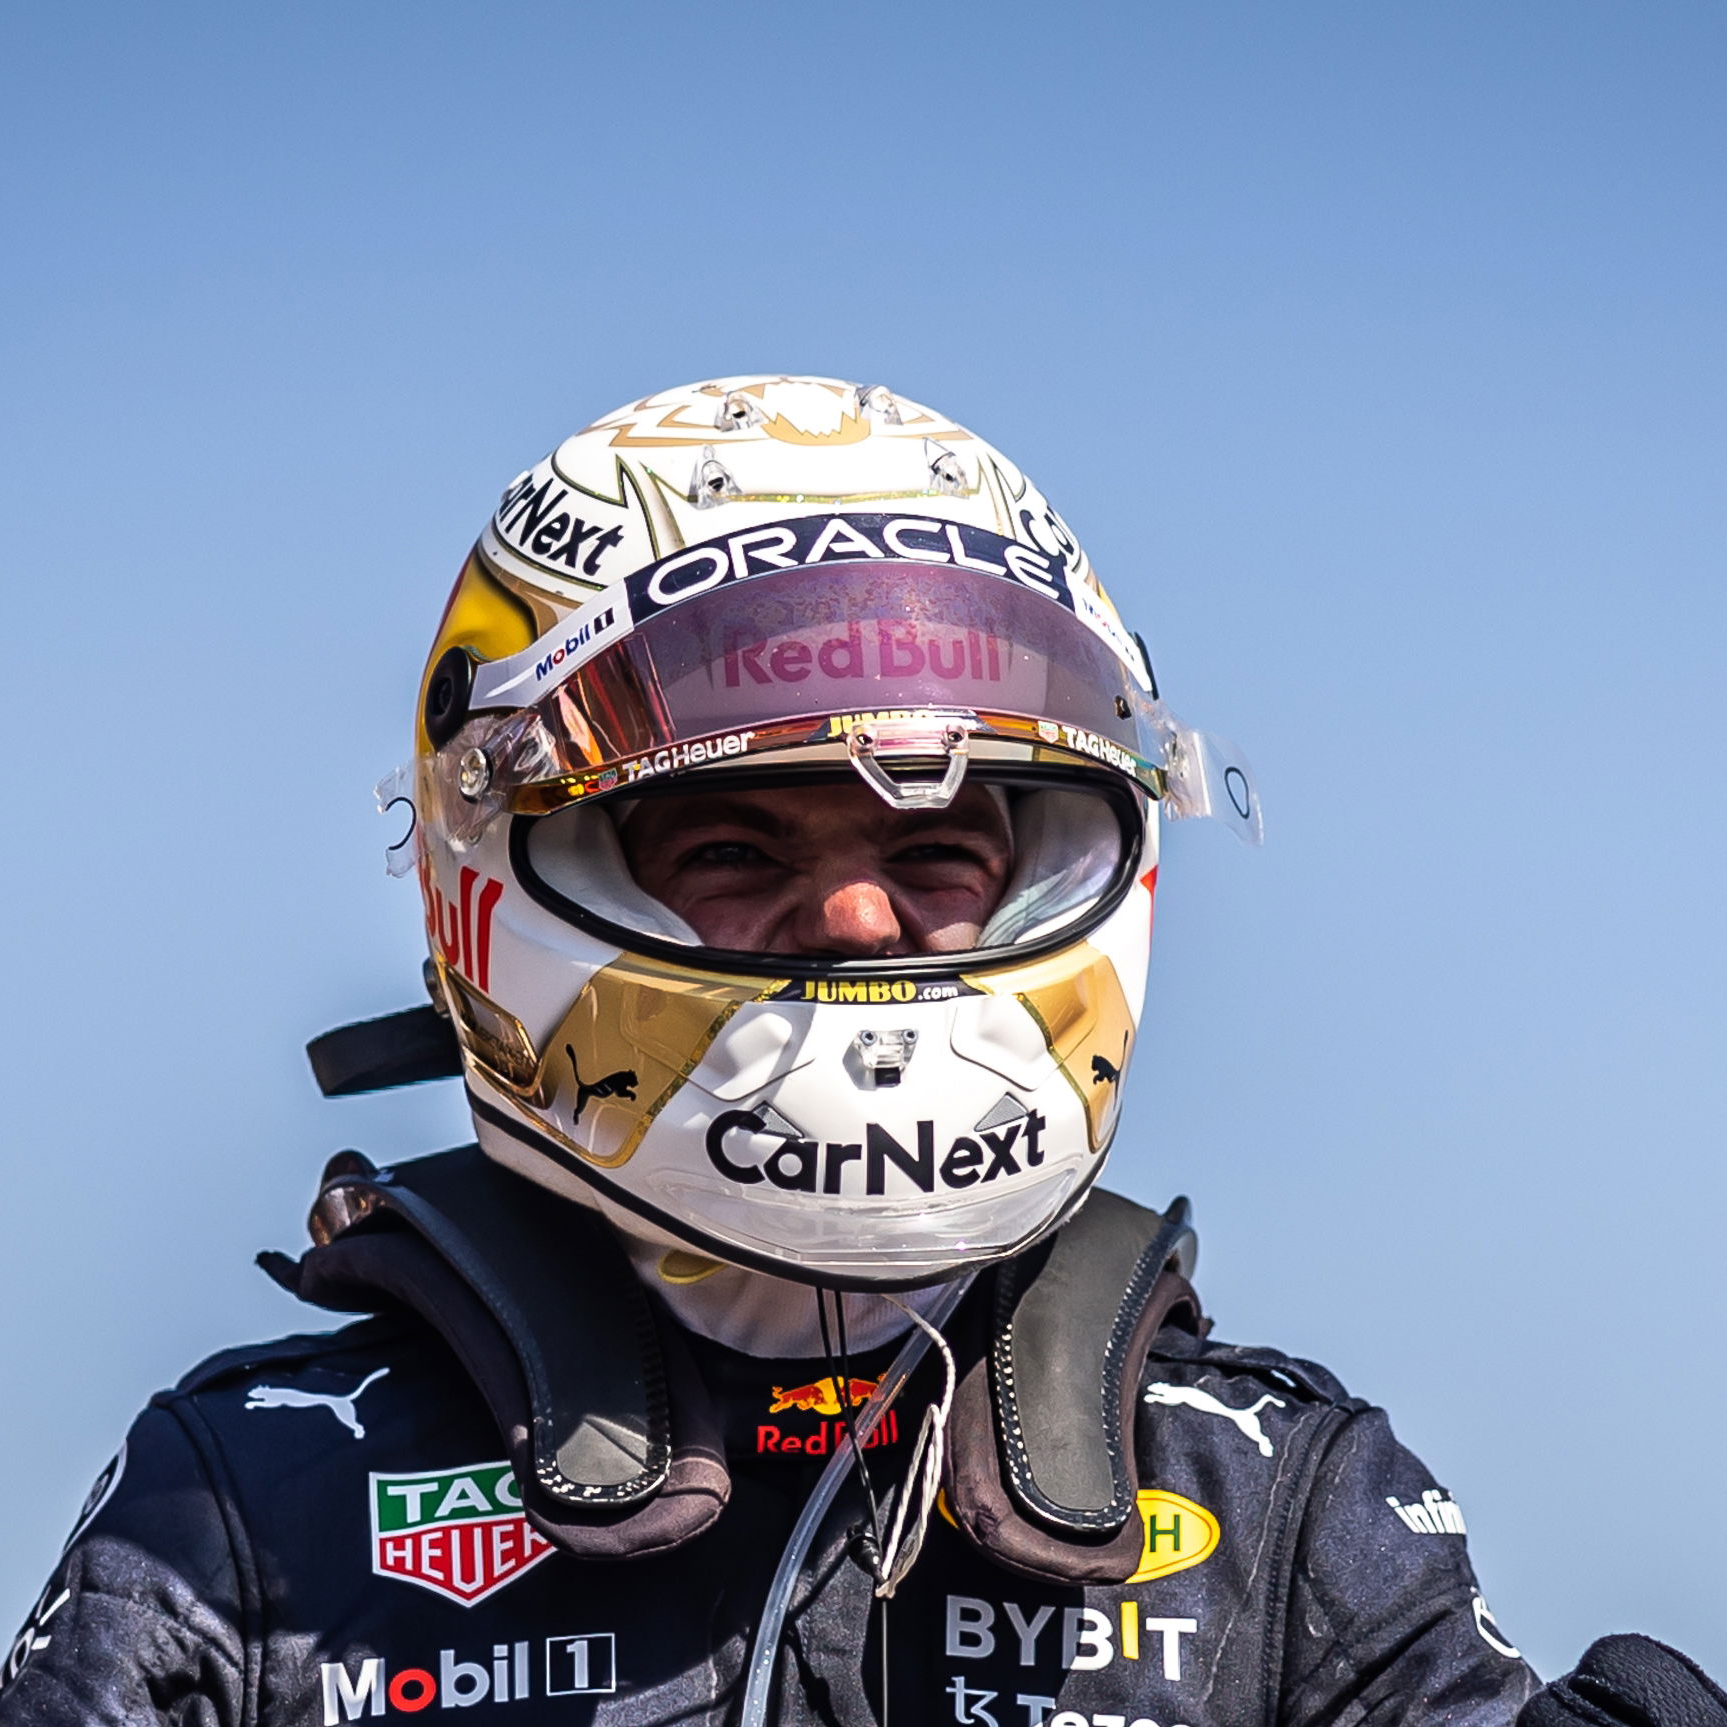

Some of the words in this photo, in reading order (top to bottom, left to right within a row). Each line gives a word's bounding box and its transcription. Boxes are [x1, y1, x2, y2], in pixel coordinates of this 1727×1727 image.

[647, 518, 1060, 606] ORACLE
[536, 624, 590, 681] Mobil
[723, 623, 864, 687] Red
[879, 620, 1001, 683] Bull
[801, 980, 959, 1002] JUMBO.com
[706, 1109, 1046, 1194] CarNext
[756, 1421, 827, 1455] Red
[946, 1595, 1197, 1681] BYBIT
[321, 1641, 529, 1727] Mobil
